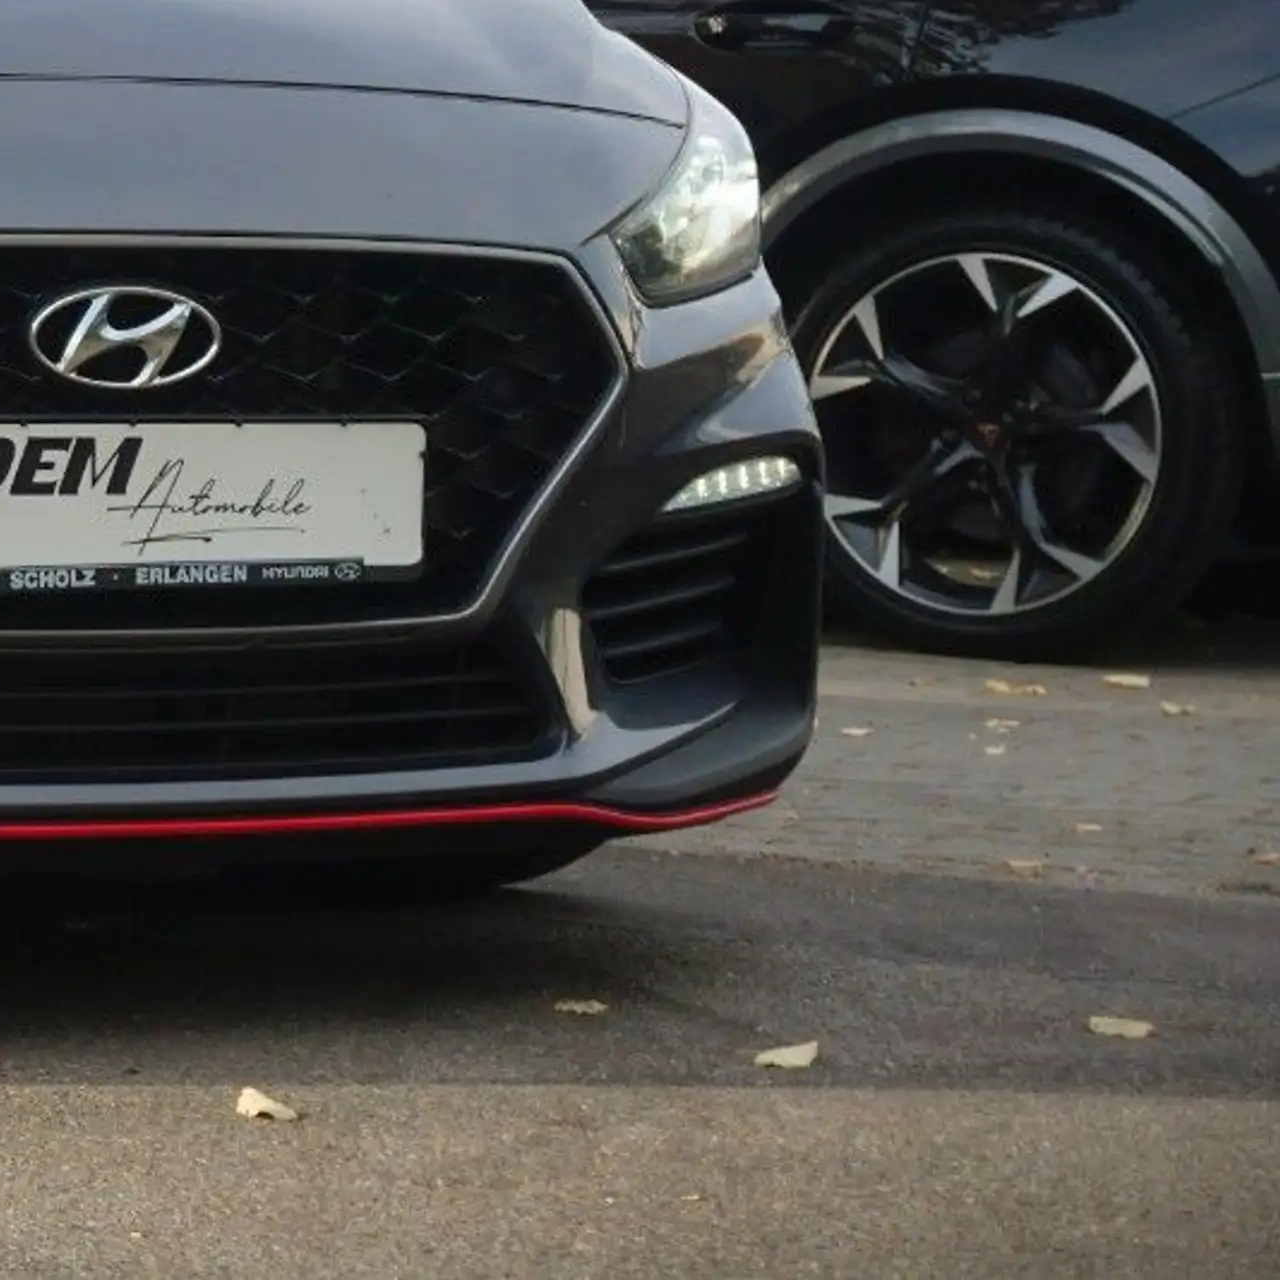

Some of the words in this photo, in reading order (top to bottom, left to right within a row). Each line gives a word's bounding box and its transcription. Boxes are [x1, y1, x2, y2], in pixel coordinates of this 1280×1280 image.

[107, 458, 311, 552] Automobile
[9, 569, 96, 590] SCHOLZ
[135, 564, 248, 585] ERLANGEN
[262, 565, 329, 580] HYUNDAI
